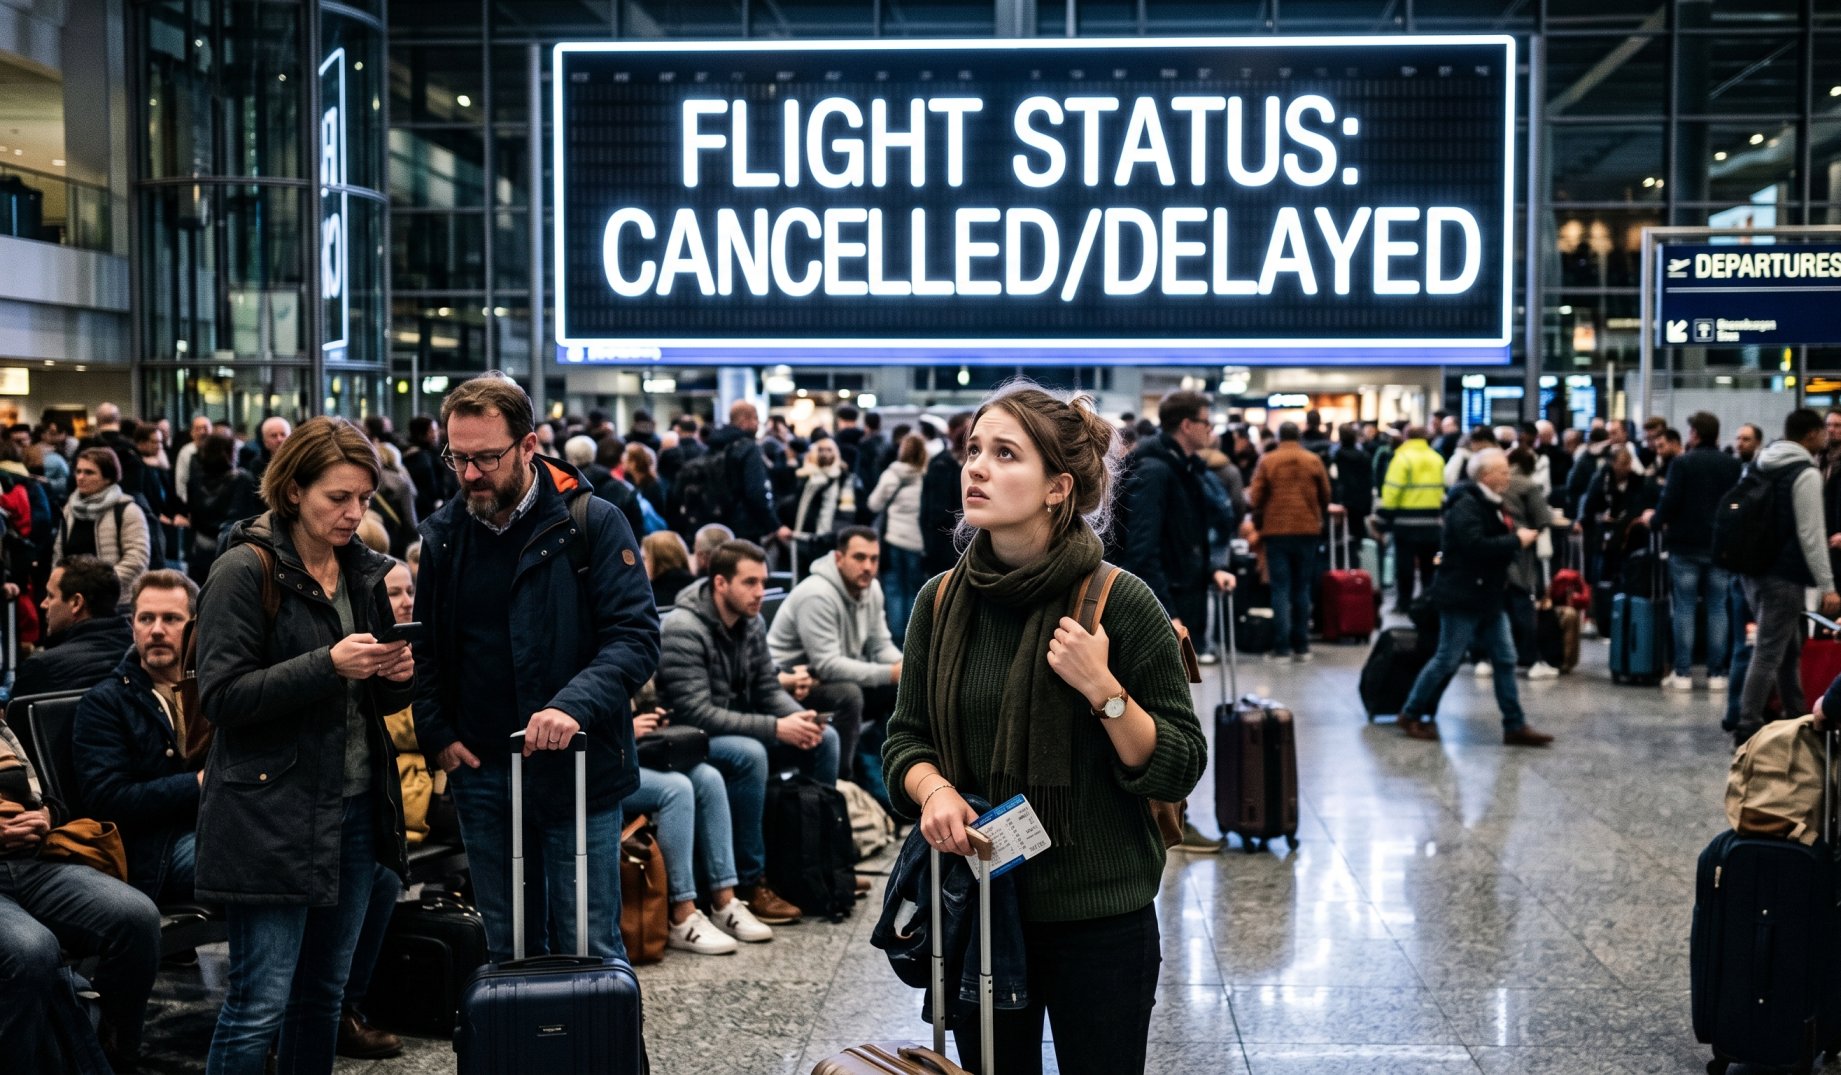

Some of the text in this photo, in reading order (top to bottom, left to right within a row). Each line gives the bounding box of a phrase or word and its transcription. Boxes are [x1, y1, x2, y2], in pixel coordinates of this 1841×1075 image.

[682, 94, 1360, 189] FLIGHT STATUS:
[602, 206, 1482, 302] CANCELLED/DELAYED
[1695, 253, 1841, 278] DEPARTURES
